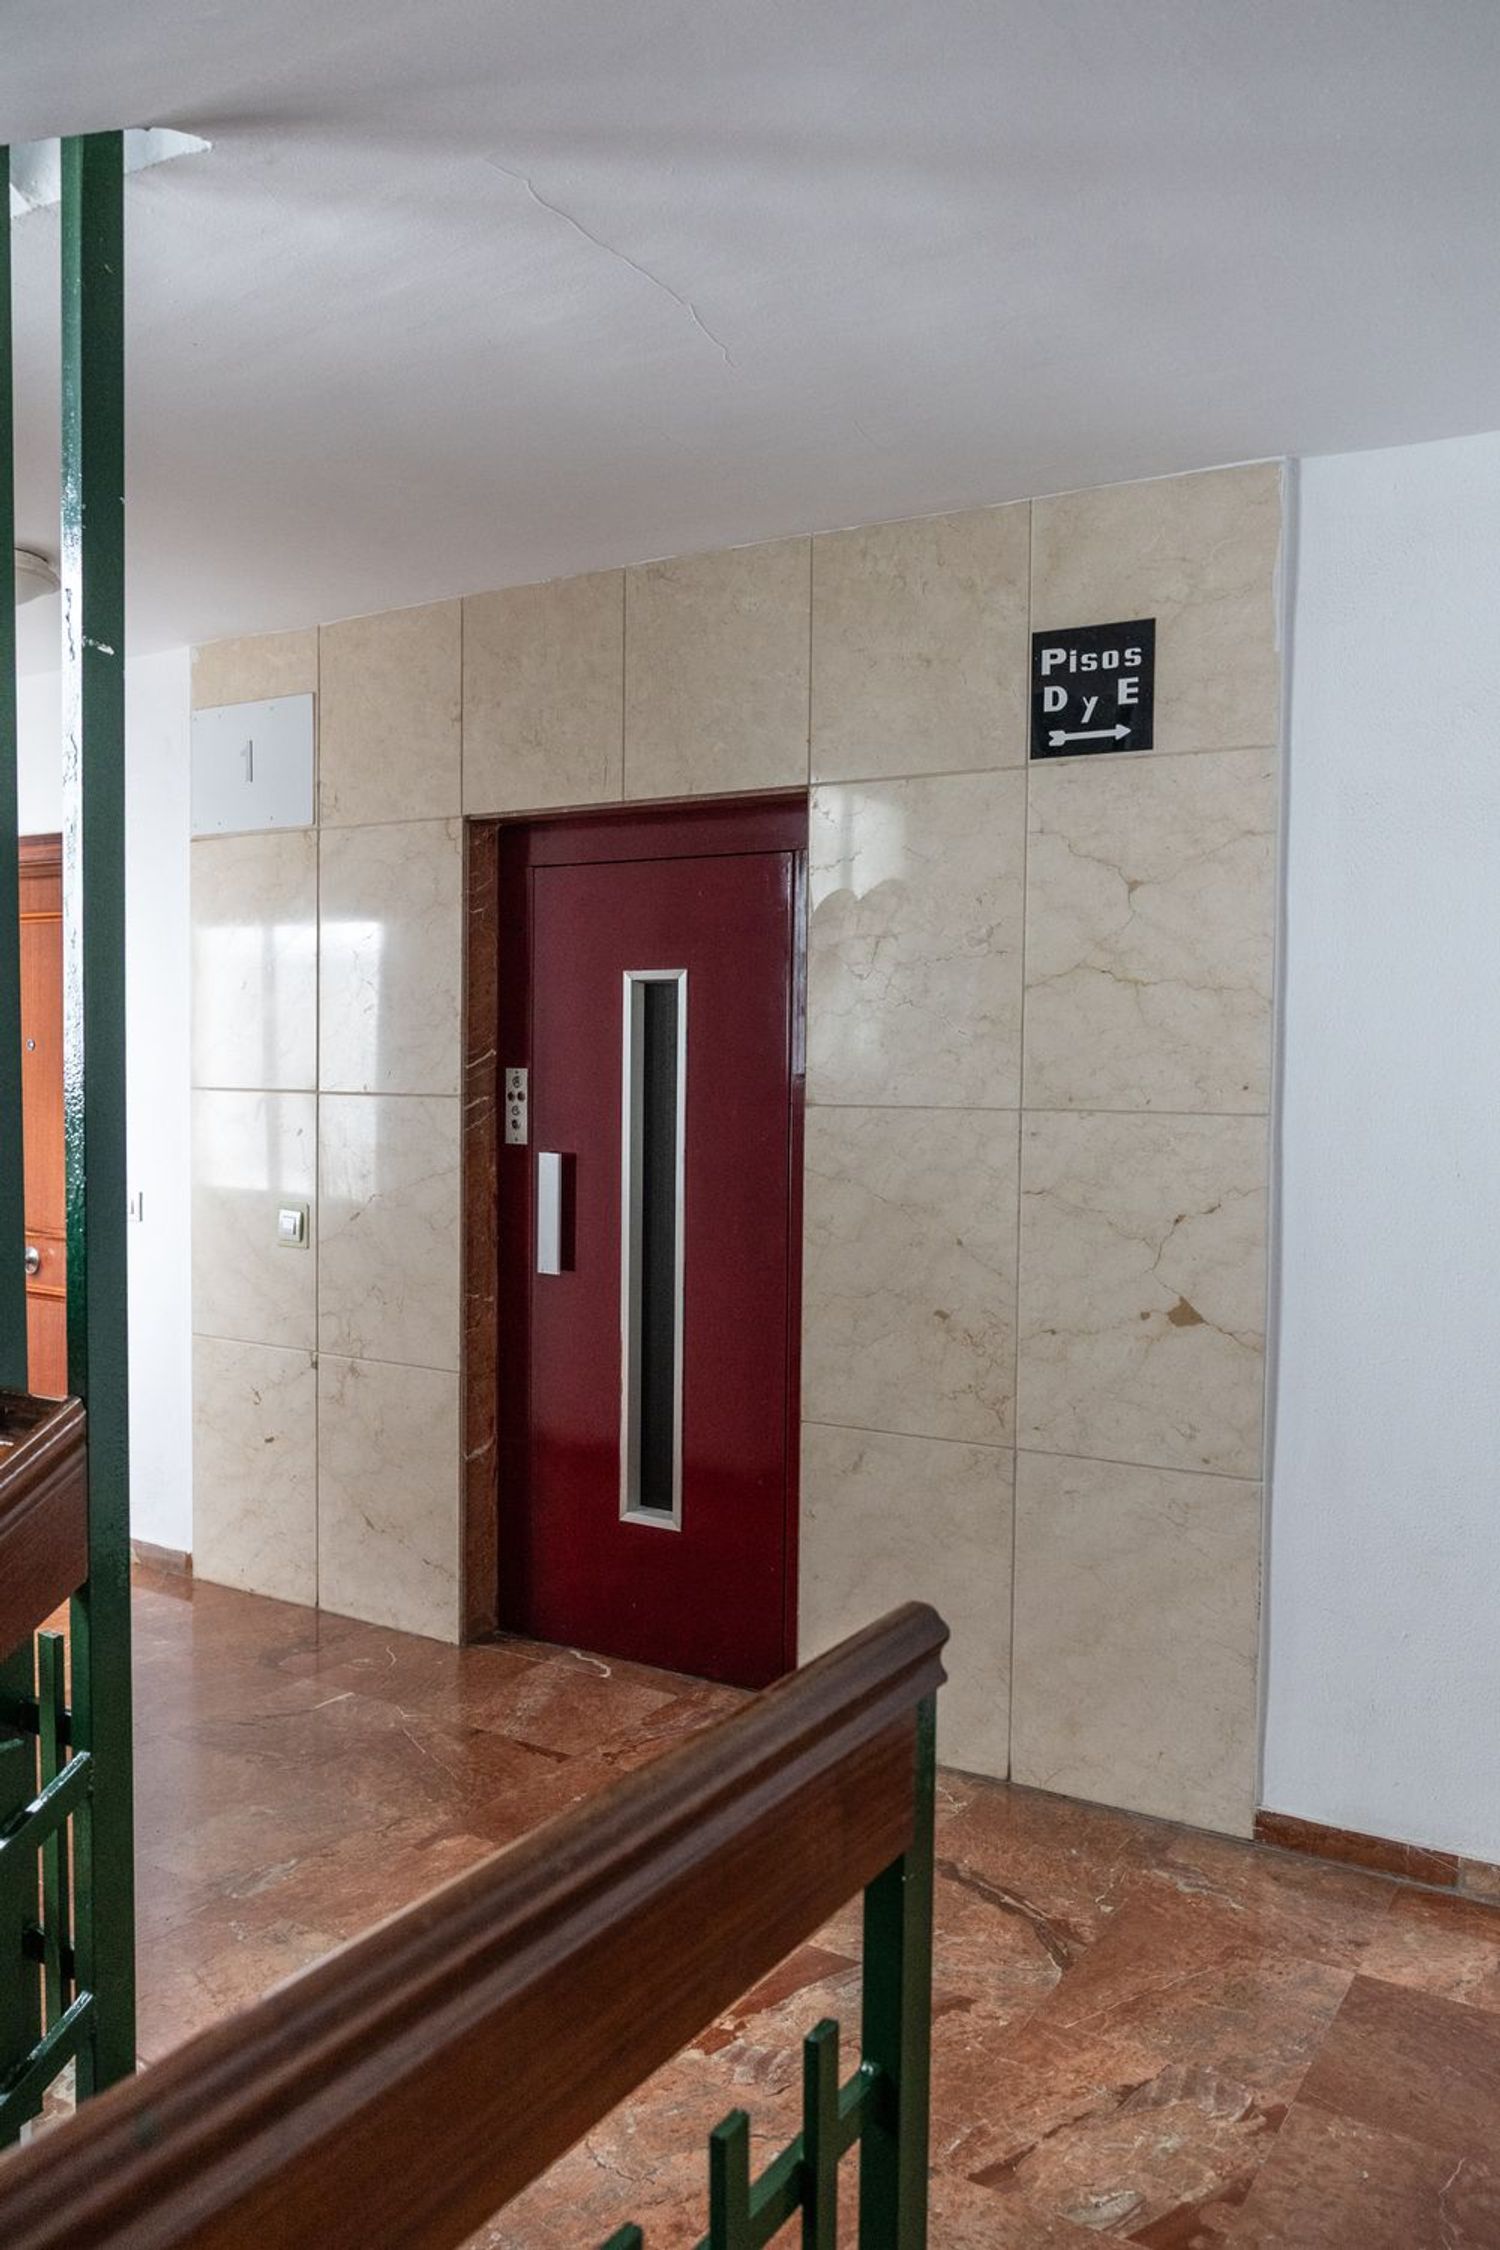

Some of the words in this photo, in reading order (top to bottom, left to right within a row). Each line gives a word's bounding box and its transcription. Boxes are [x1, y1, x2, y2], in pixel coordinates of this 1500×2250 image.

[1041, 647, 1142, 676] Pisos
[1043, 685, 1068, 712] D
[1081, 696, 1099, 724] y
[1117, 677, 1139, 705] E
